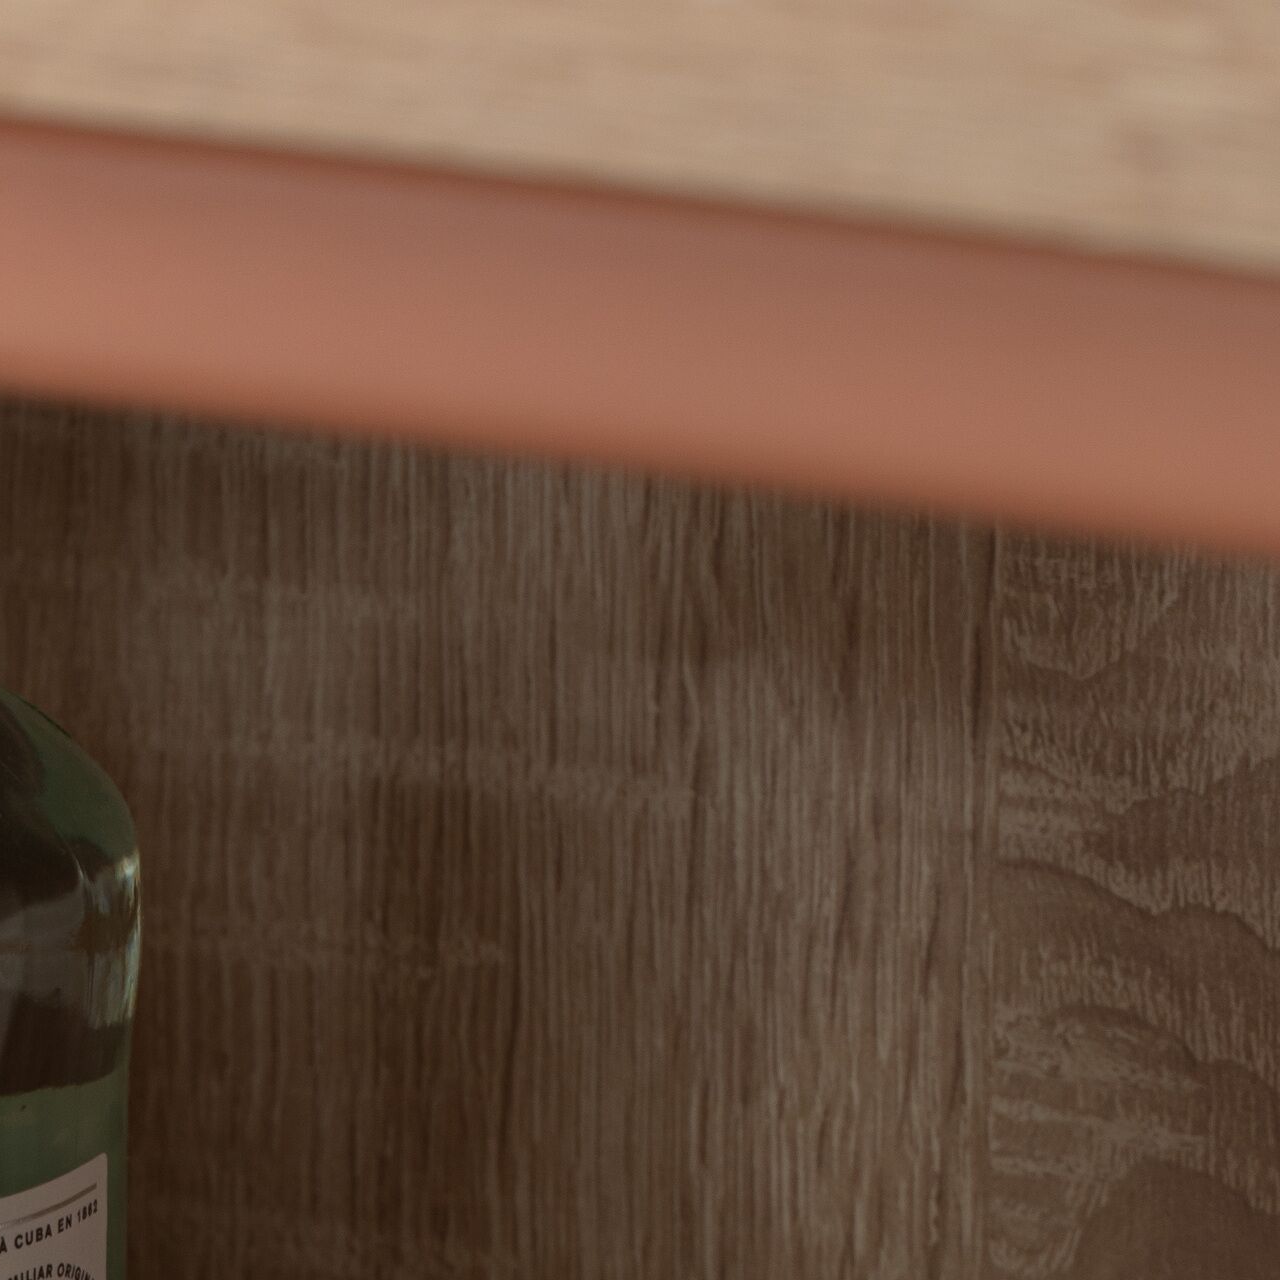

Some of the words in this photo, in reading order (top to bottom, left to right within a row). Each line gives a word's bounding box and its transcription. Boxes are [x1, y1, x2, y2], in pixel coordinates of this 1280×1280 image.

[14, 1224, 53, 1250] CUBA
[57, 1215, 73, 1235] EN
[77, 1200, 99, 1223] 1862
